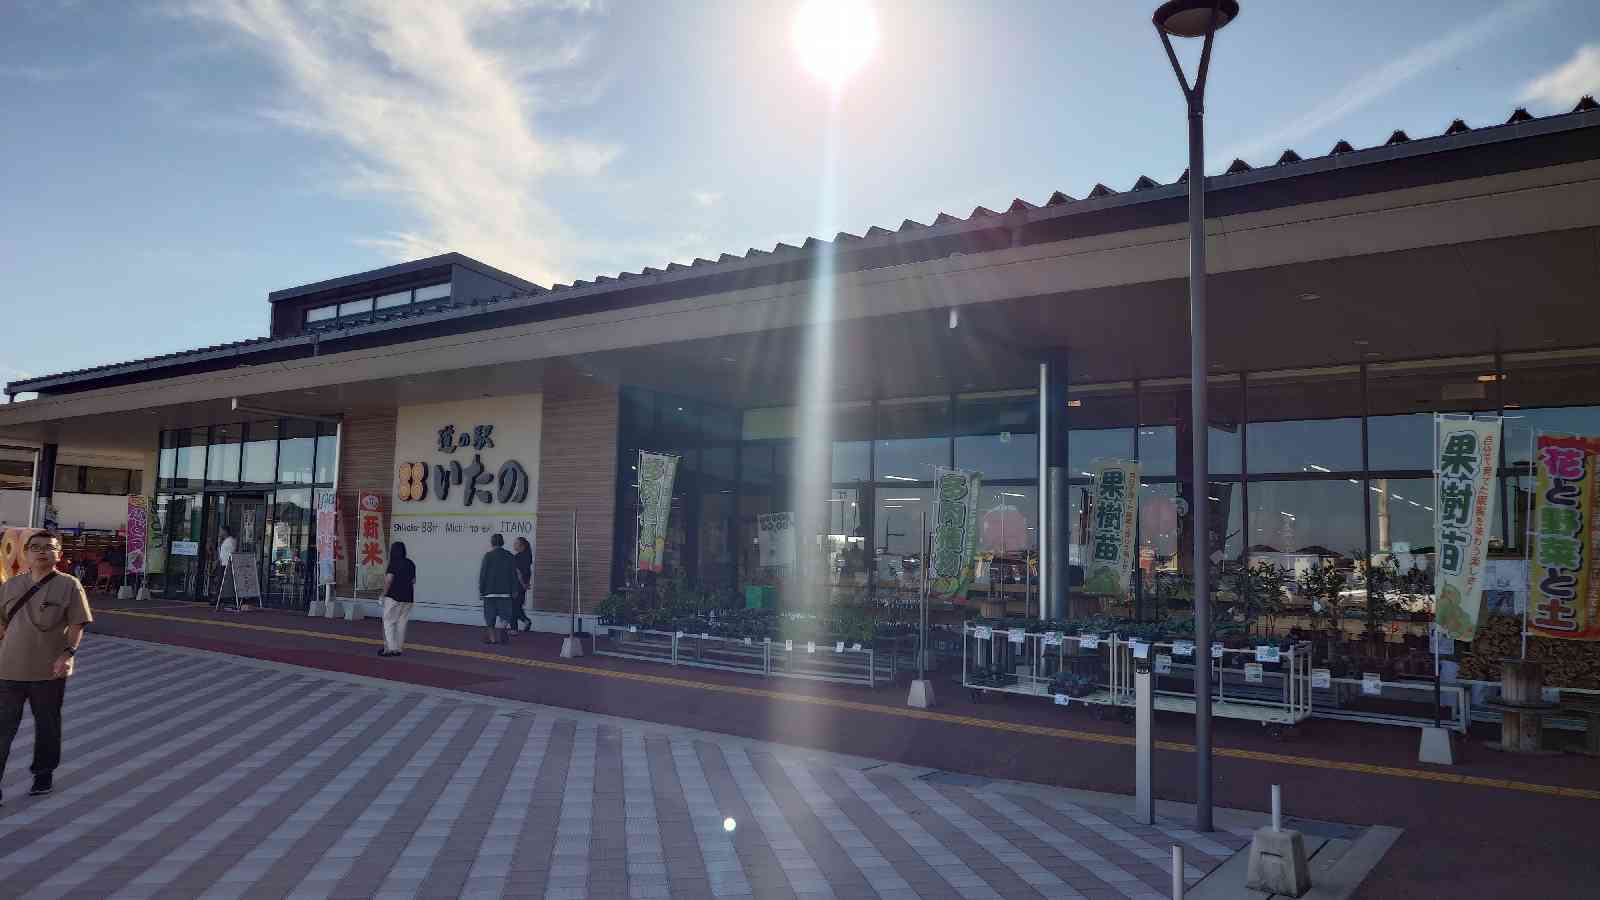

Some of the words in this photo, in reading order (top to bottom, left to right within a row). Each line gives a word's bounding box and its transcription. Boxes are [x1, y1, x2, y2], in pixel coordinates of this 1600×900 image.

[433, 454, 528, 506] いたの
[1440, 432, 1478, 574] 果樹苗
[361, 515, 384, 567] 新米
